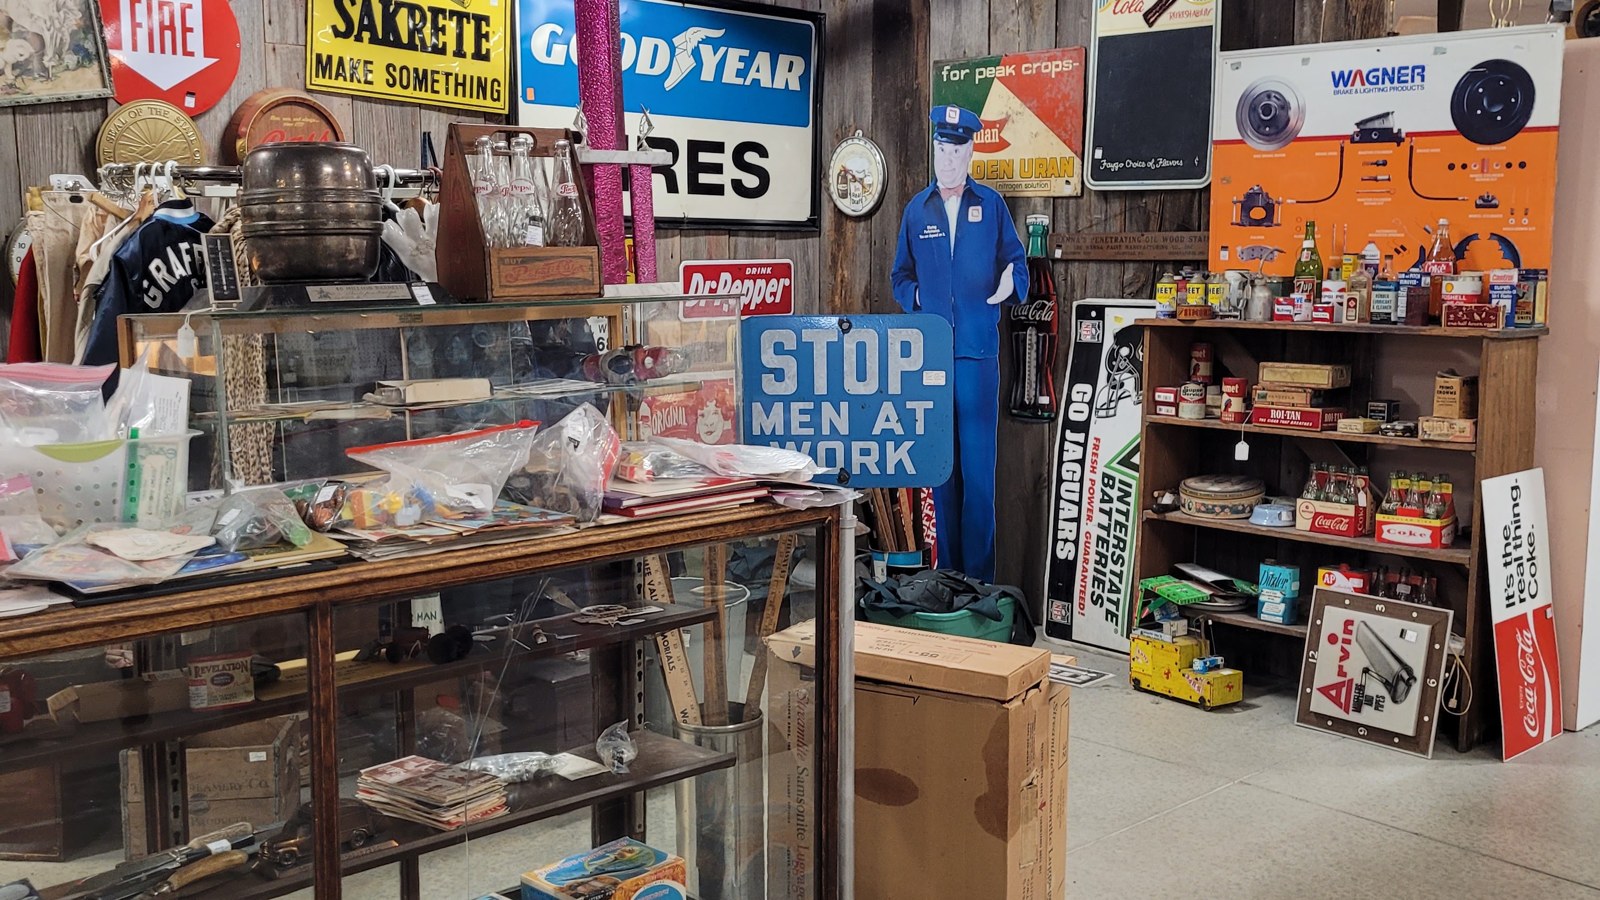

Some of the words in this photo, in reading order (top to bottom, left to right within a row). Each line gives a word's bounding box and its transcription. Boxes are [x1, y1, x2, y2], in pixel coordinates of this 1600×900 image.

[1112, 0, 1144, 15] Cola
[130, 0, 195, 57] FIRE
[331, 0, 491, 62] SAKRETE
[530, 23, 806, 91] GDYEAR
[941, 65, 970, 82] for
[975, 63, 1015, 84] peak
[1021, 58, 1080, 78] crops-
[315, 53, 374, 86] MAKE
[385, 62, 501, 103] SOMETHING
[1331, 64, 1426, 88] WAGNER
[1359, 86, 1389, 94] LIGHTING
[1389, 84, 1425, 92] PRODUCTS
[105, 116, 128, 145] SEAL
[128, 106, 144, 119] OF
[147, 106, 170, 119] THE
[173, 116, 197, 146] STATE
[973, 124, 1000, 144] dian
[612, 131, 771, 199] RES
[971, 158, 1015, 180] DEN
[1019, 156, 1075, 179] URAN
[1100, 160, 1124, 171] Faygo
[1125, 159, 1146, 168] Choice
[1147, 159, 1156, 169] of
[1156, 158, 1183, 168] Flavors
[998, 183, 1023, 191] nitrogen
[1024, 181, 1049, 190] solution
[1145, 235, 1159, 243] OIL
[1162, 235, 1185, 243] WOOD
[745, 267, 772, 275] DRINK
[685, 272, 717, 307] Dr
[714, 271, 791, 312] Pepper
[1011, 300, 1055, 322] Coca-Cola
[1080, 322, 1092, 341] NFL
[760, 328, 924, 395] STOP
[1068, 382, 1093, 422] GO
[1183, 386, 1204, 394] Super
[652, 405, 688, 434] ORIGINAL
[751, 401, 849, 436] MEN
[871, 401, 934, 436] AT
[1089, 436, 1101, 474] FRESH
[1055, 431, 1086, 561] JAGUARS
[1084, 478, 1097, 526] POWER.
[1510, 478, 1523, 550] thing.
[1090, 471, 1117, 609] BATTERIES
[1315, 515, 1350, 531] Coca-Cola
[1386, 528, 1426, 537] Coke
[1105, 478, 1133, 634] INTERSTATE
[1502, 524, 1512, 566] the
[1527, 524, 1539, 600] Coke.
[647, 580, 659, 602] VAL
[1077, 530, 1092, 617] GUARANTEED!
[1323, 573, 1336, 584] AP
[1505, 573, 1516, 610] It's
[1514, 560, 1526, 604] real
[1375, 604, 1385, 613] 3
[193, 660, 250, 678] REVELATION
[661, 632, 676, 674] MORIALS,
[1308, 650, 1318, 663] 12
[1316, 619, 1355, 715] Arvin
[1516, 628, 1540, 738] Coca-Cola
[1374, 694, 1386, 712] PIPES
[796, 690, 810, 762] Streamlite
[189, 782, 243, 792] EAMERY
[796, 765, 809, 841] Samsonite
[1045, 848, 1055, 900] Lugga
